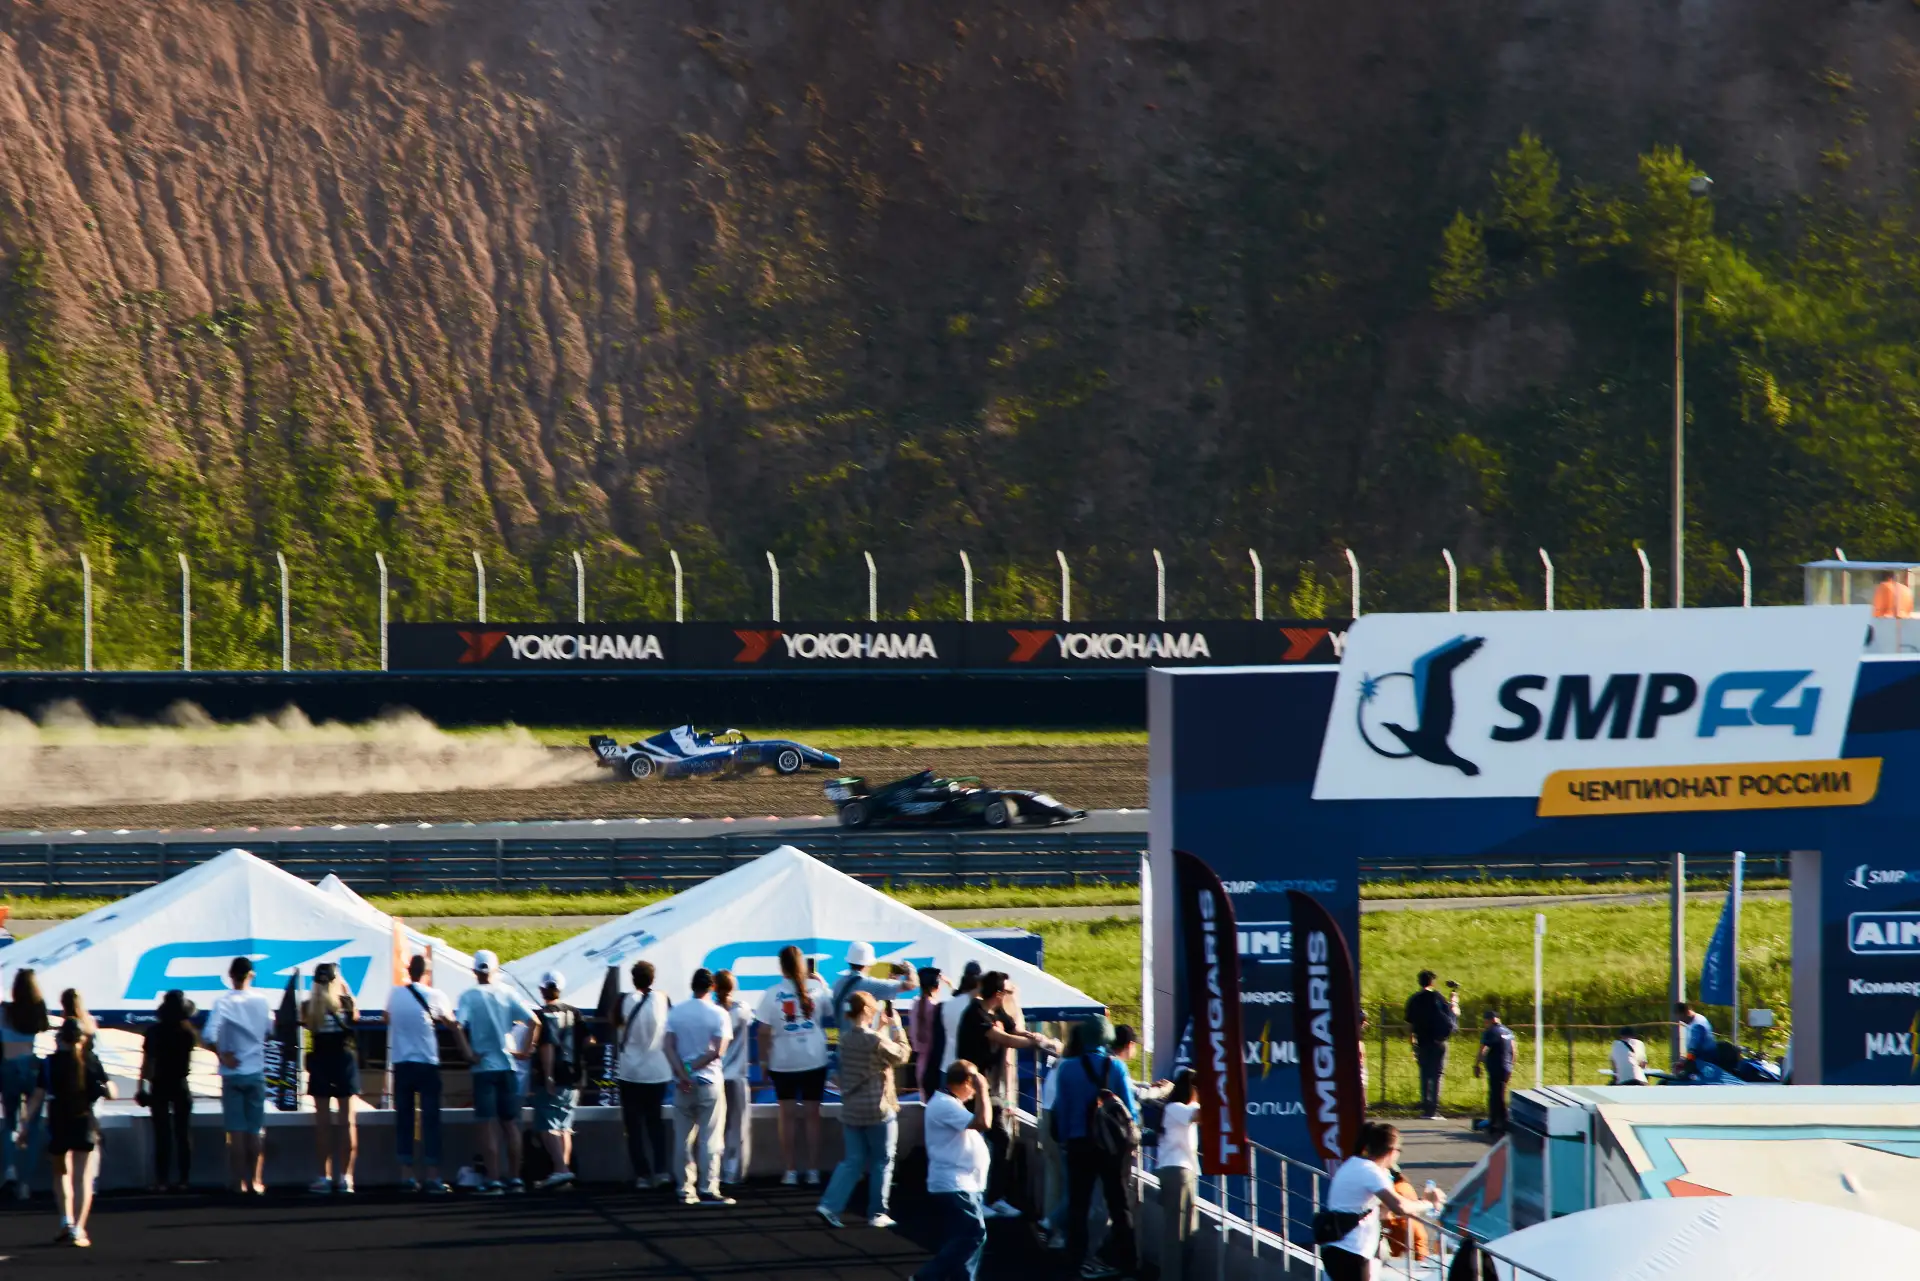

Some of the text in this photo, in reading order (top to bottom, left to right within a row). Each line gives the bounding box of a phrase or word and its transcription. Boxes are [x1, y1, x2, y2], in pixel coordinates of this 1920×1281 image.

[505, 634, 664, 660] YOKOHAMA
[782, 633, 938, 659] YOKOHAMA
[1055, 633, 1211, 659] YOKOHAMA
[1568, 771, 1852, 802] ЧЕМПИОНАТ РОССИИ
